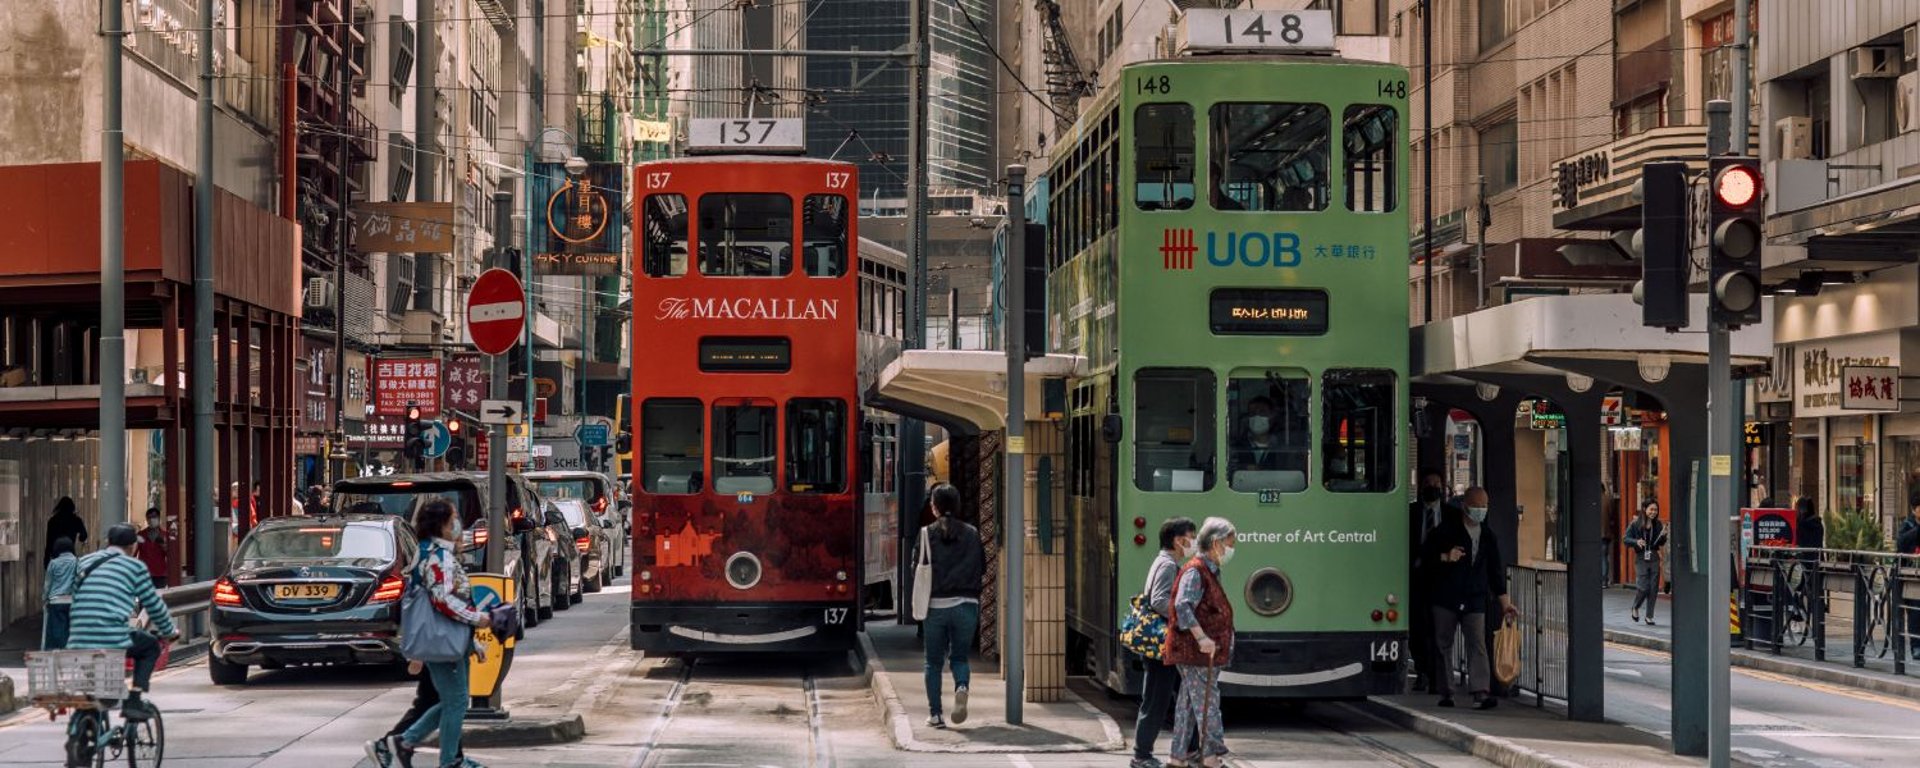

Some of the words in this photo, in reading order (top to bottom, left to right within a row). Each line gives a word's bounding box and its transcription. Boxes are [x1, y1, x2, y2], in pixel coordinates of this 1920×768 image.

[1224, 14, 1304, 44] 148
[1137, 75, 1171, 95] 148
[1377, 79, 1406, 99] 148
[719, 121, 777, 144] 137
[646, 172, 671, 189] 137
[825, 172, 850, 188] 137
[536, 254, 573, 263] SKY
[575, 255, 618, 263] CUISINE
[1206, 231, 1302, 268] UOB
[1313, 244, 1375, 260] 大華銀行
[655, 297, 690, 321] The
[691, 298, 839, 320] MACALLAN
[1234, 530, 1282, 543] artner
[1285, 529, 1302, 543] of
[1303, 530, 1325, 543] Art
[1328, 529, 1377, 543] Central
[282, 588, 300, 597] DV
[305, 588, 329, 597] 339
[824, 607, 849, 625] 137
[1370, 640, 1399, 662] 148
